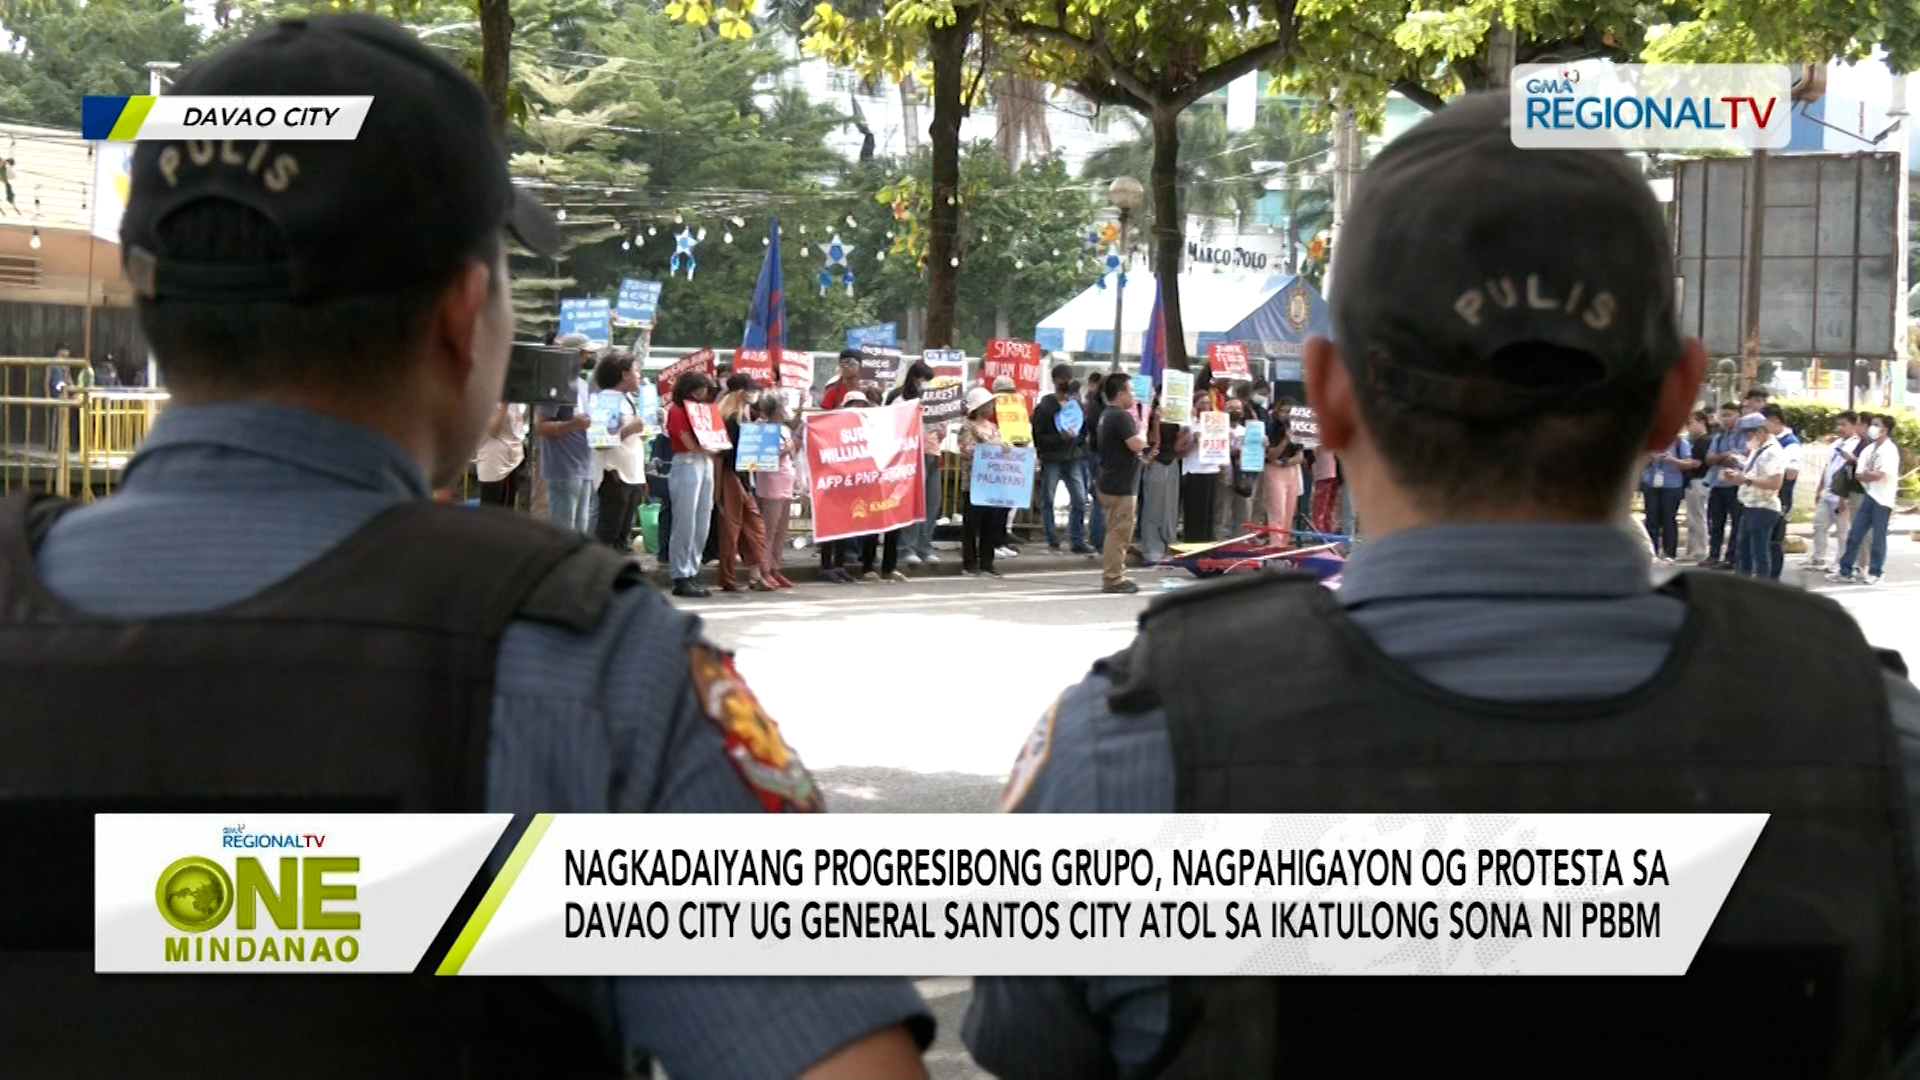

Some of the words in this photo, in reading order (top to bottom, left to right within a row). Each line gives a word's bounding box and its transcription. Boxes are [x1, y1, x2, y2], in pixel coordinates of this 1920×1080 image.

[159, 139, 300, 192] PULIS
[1188, 241, 1231, 266] MARCO
[1234, 246, 1267, 270] POLO
[1454, 273, 1617, 330] PULIS
[816, 474, 843, 490] AFP
[843, 475, 854, 487] &
[855, 470, 880, 486] PNP
